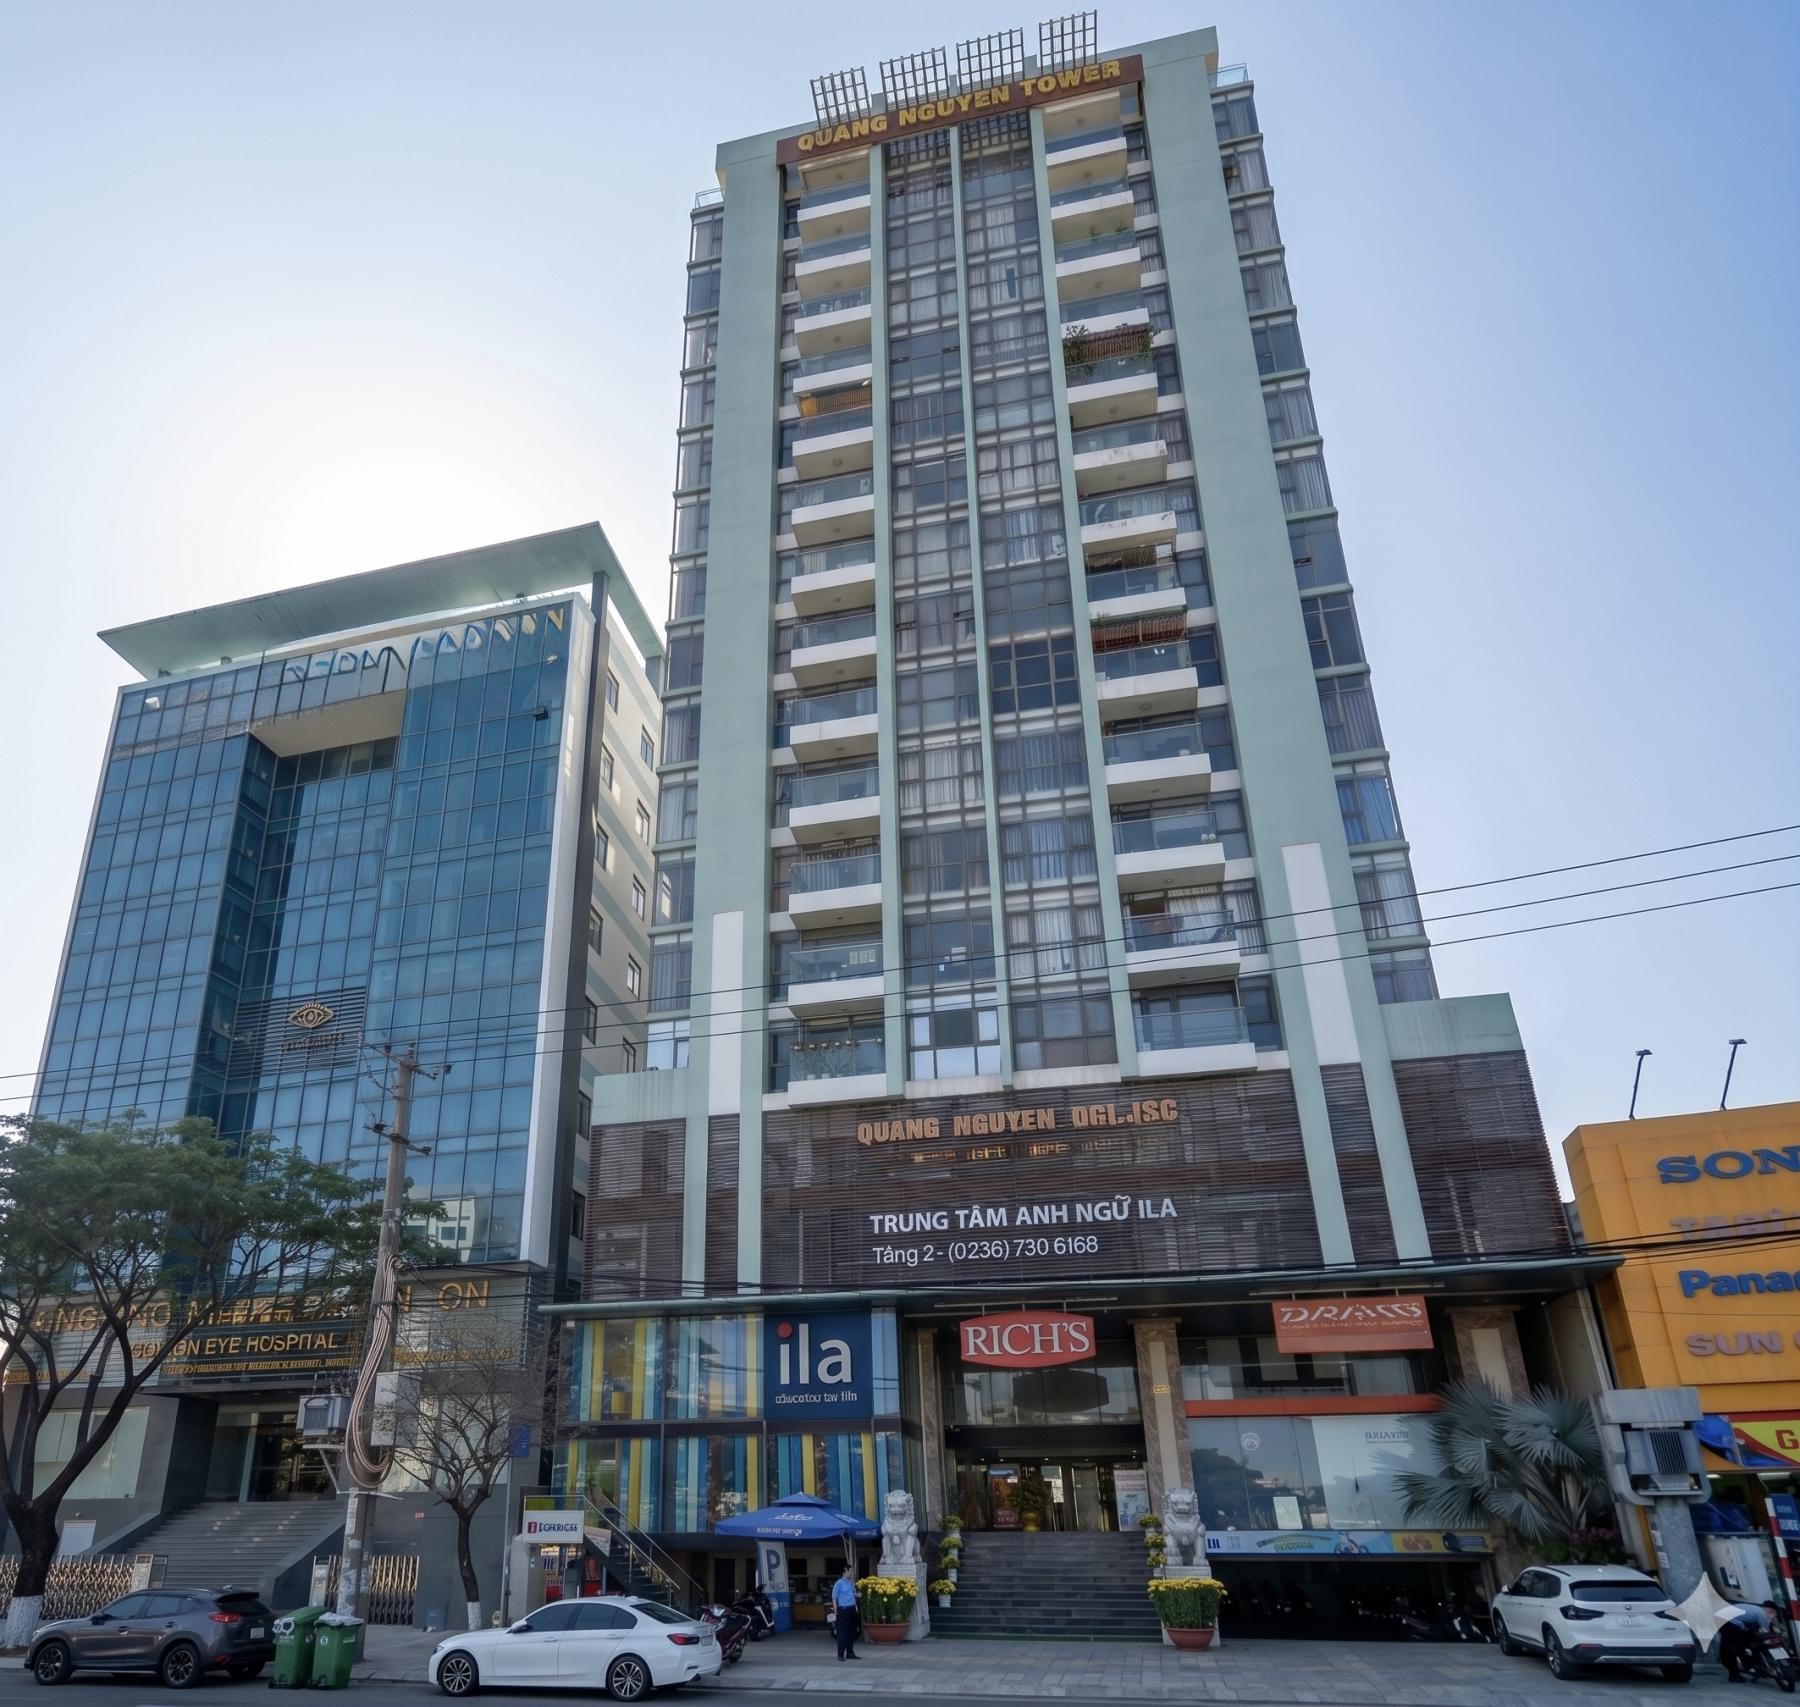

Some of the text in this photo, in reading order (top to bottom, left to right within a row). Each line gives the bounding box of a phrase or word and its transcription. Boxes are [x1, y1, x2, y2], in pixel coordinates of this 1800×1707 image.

[797, 60, 1122, 151] QUANG NGUYEN TOWER
[857, 1117, 940, 1145] QUANG
[954, 1108, 1056, 1136] NGUYEN
[870, 1195, 1178, 1234] TRUNG TÂM ANH NGỮ ILA
[949, 1240, 1010, 1262] (0236)
[1014, 1238, 1049, 1257] 730
[1053, 1236, 1099, 1255] 6168
[1678, 1269, 1800, 1298] Pana
[205, 1338, 242, 1355] EYE
[777, 1321, 853, 1386] ila
[965, 1321, 1091, 1356] RICH'S
[1686, 1331, 1784, 1357] SUN
